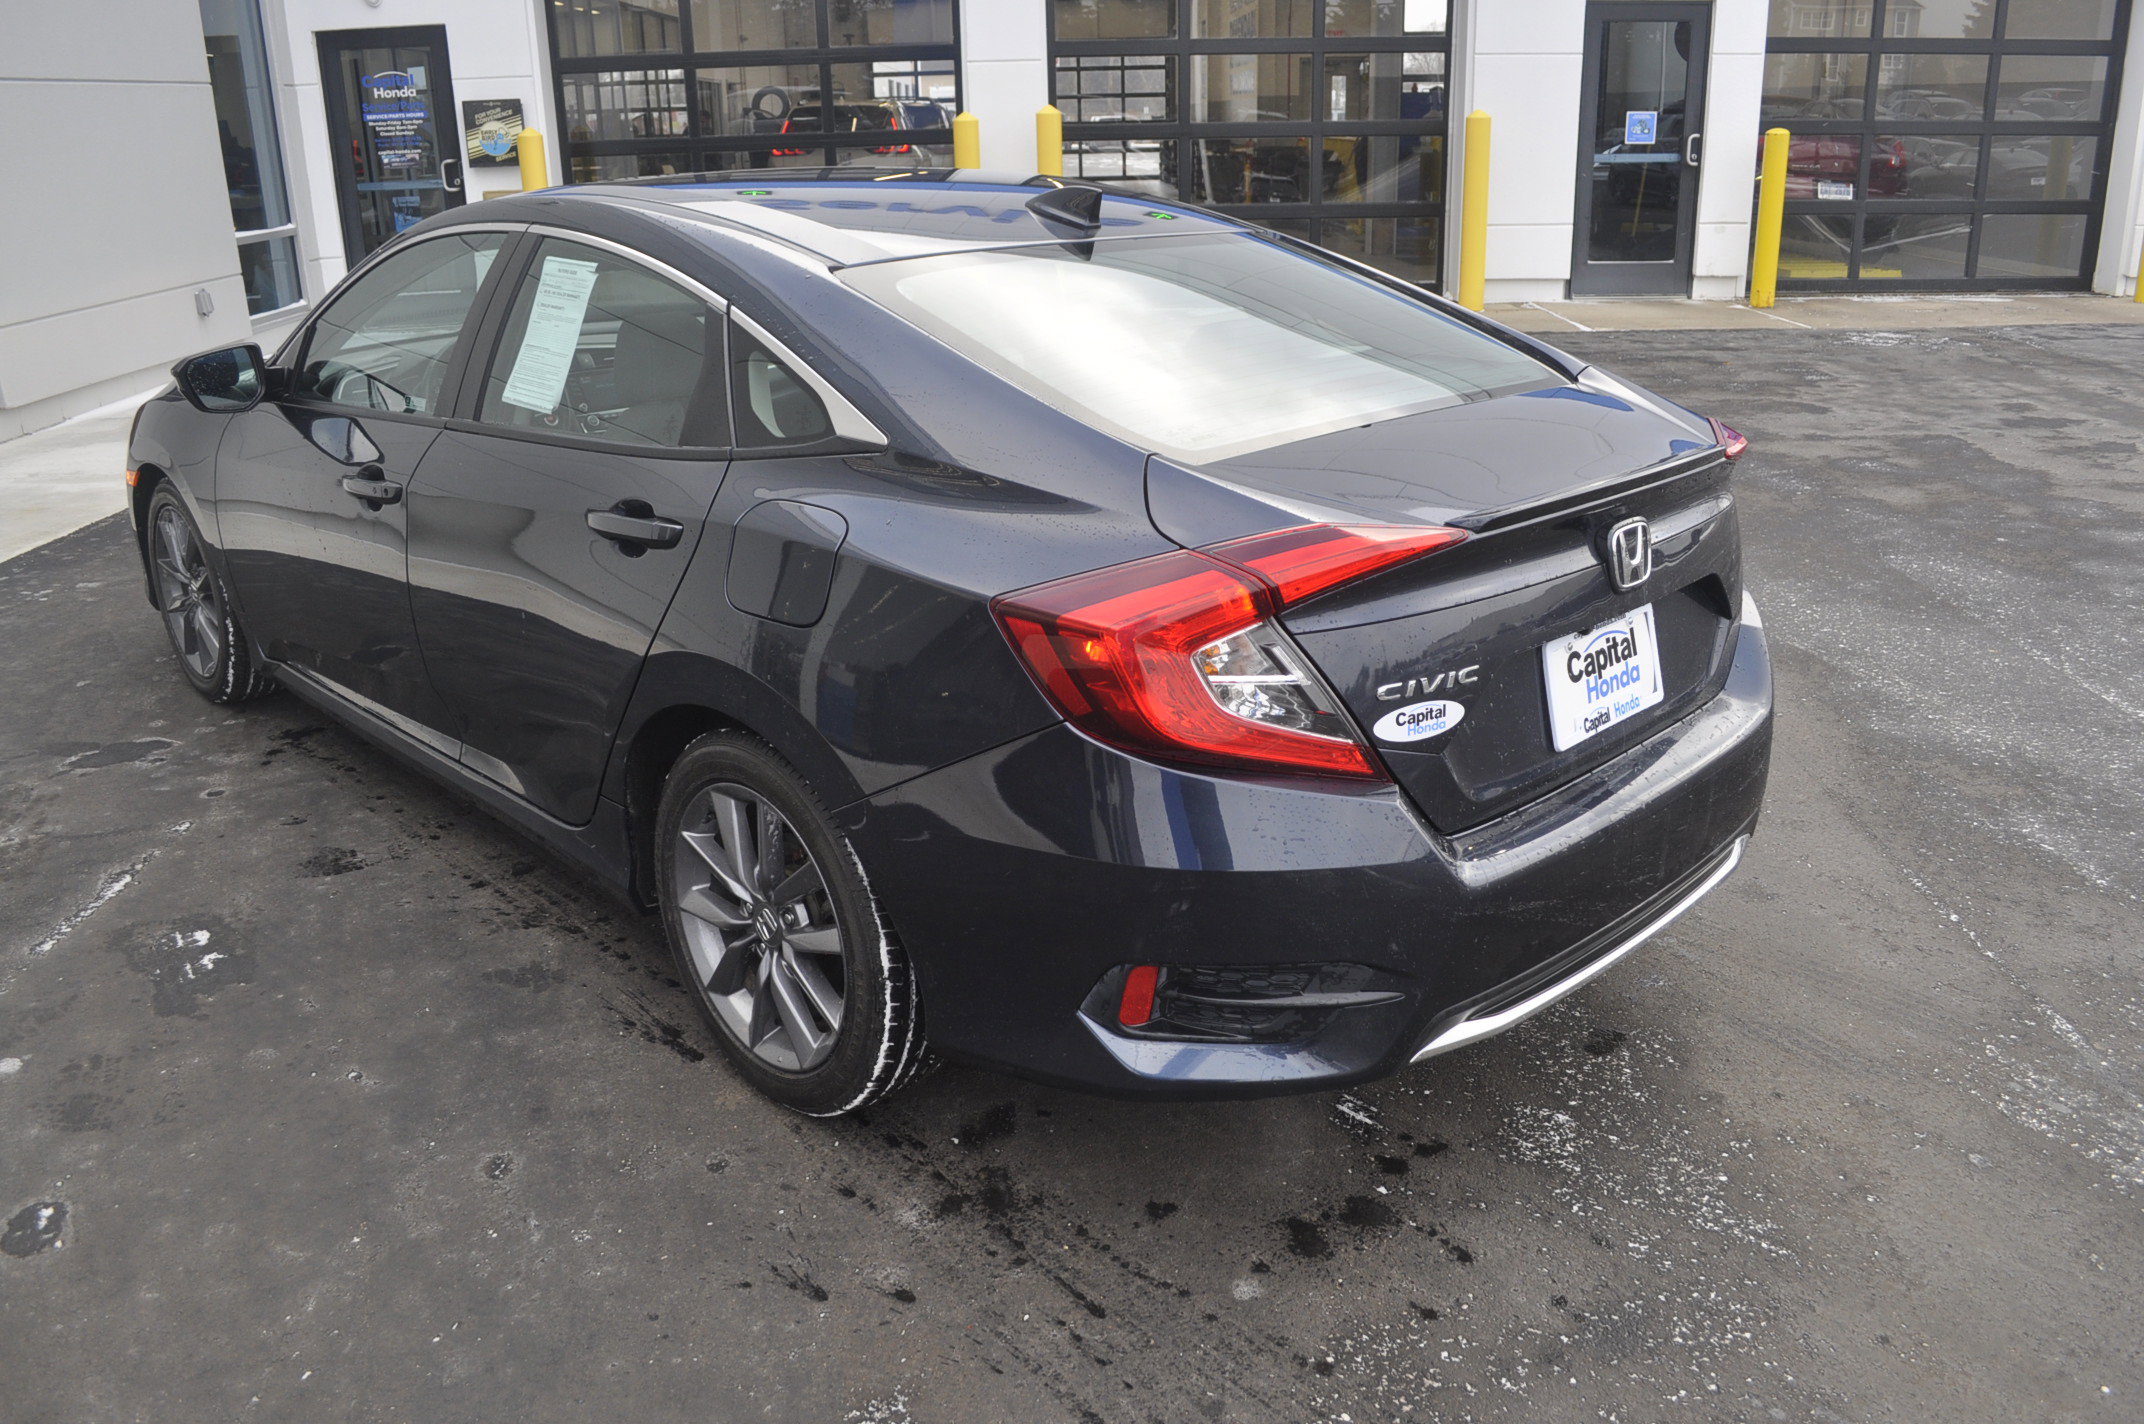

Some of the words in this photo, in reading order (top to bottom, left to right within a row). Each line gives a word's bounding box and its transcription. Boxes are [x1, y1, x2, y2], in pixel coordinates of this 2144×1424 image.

[361, 74, 415, 90] Capital
[373, 85, 416, 99] Honda
[1567, 627, 1638, 683] Capital
[1377, 664, 1480, 700] CIVIC
[1586, 660, 1641, 704] Honda
[1395, 704, 1447, 726] Capital
[1407, 716, 1447, 736] Honda
[1583, 706, 1611, 733] Capital
[1613, 693, 1640, 718] Honda
